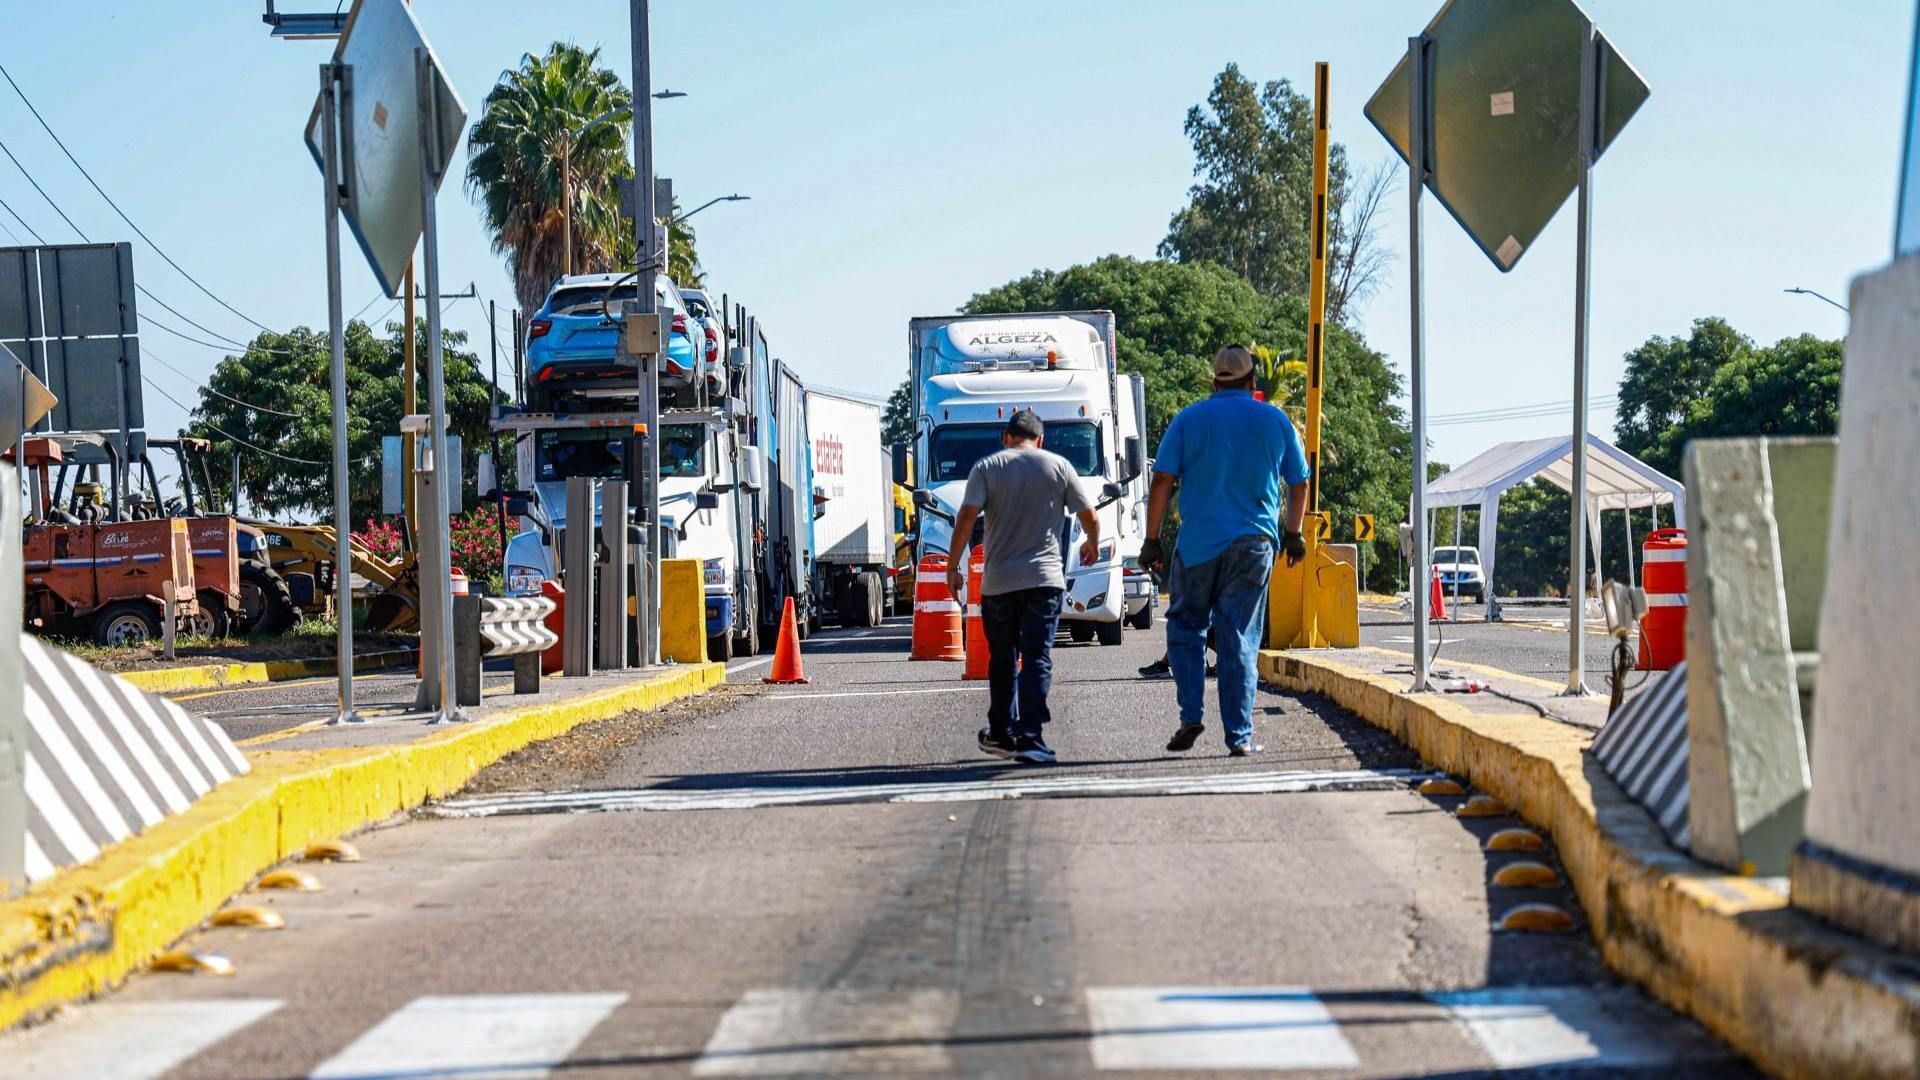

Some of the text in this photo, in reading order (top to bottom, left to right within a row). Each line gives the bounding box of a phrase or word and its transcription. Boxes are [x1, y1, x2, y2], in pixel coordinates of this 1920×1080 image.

[968, 334, 1058, 346] ALGEZA
[816, 432, 843, 475] estafeta
[265, 534, 282, 546] 16E
